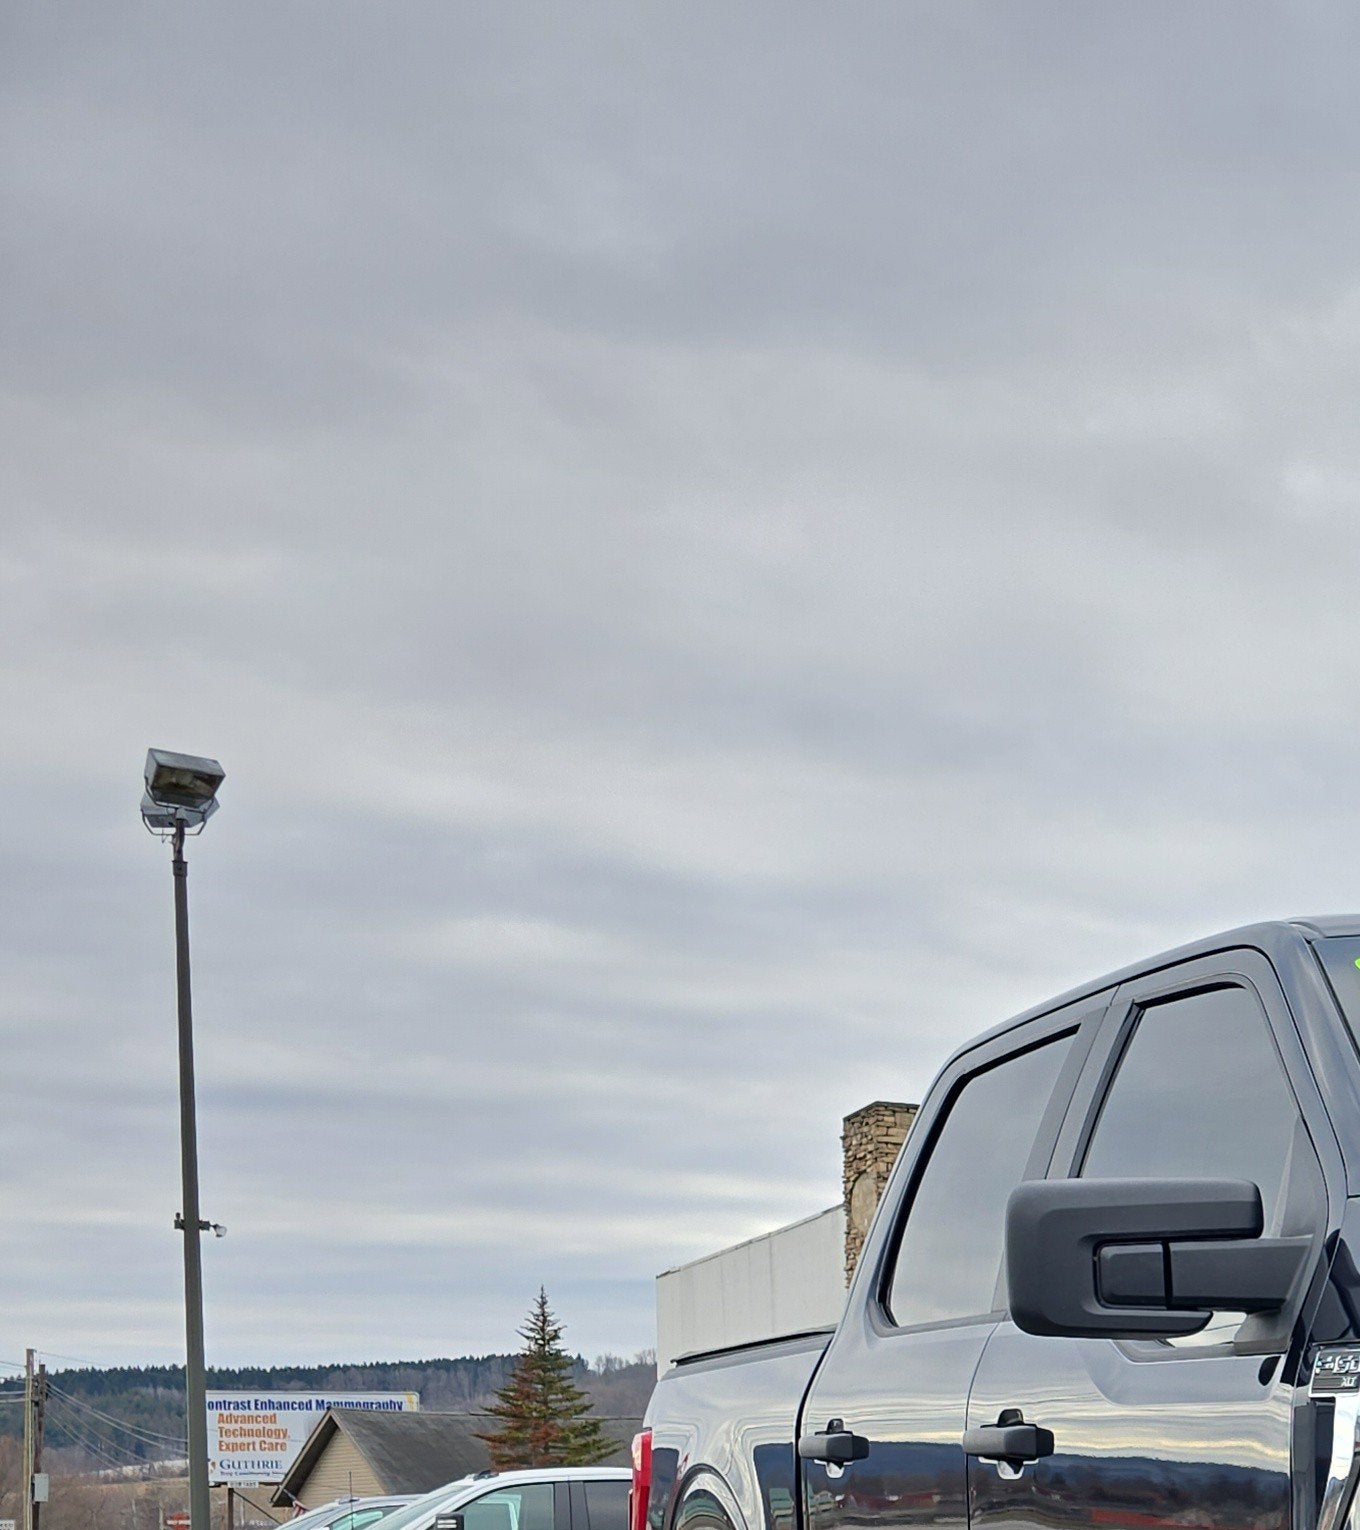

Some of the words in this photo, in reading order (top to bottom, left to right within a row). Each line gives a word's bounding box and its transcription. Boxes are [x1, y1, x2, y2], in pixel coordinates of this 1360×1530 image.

[207, 1399, 251, 1411] ontrast
[254, 1399, 313, 1411] Enhanced
[217, 1413, 278, 1425] Advanced
[218, 1440, 256, 1453] Expert
[259, 1440, 287, 1451] Care
[219, 1459, 283, 1469] GUTHRIE
